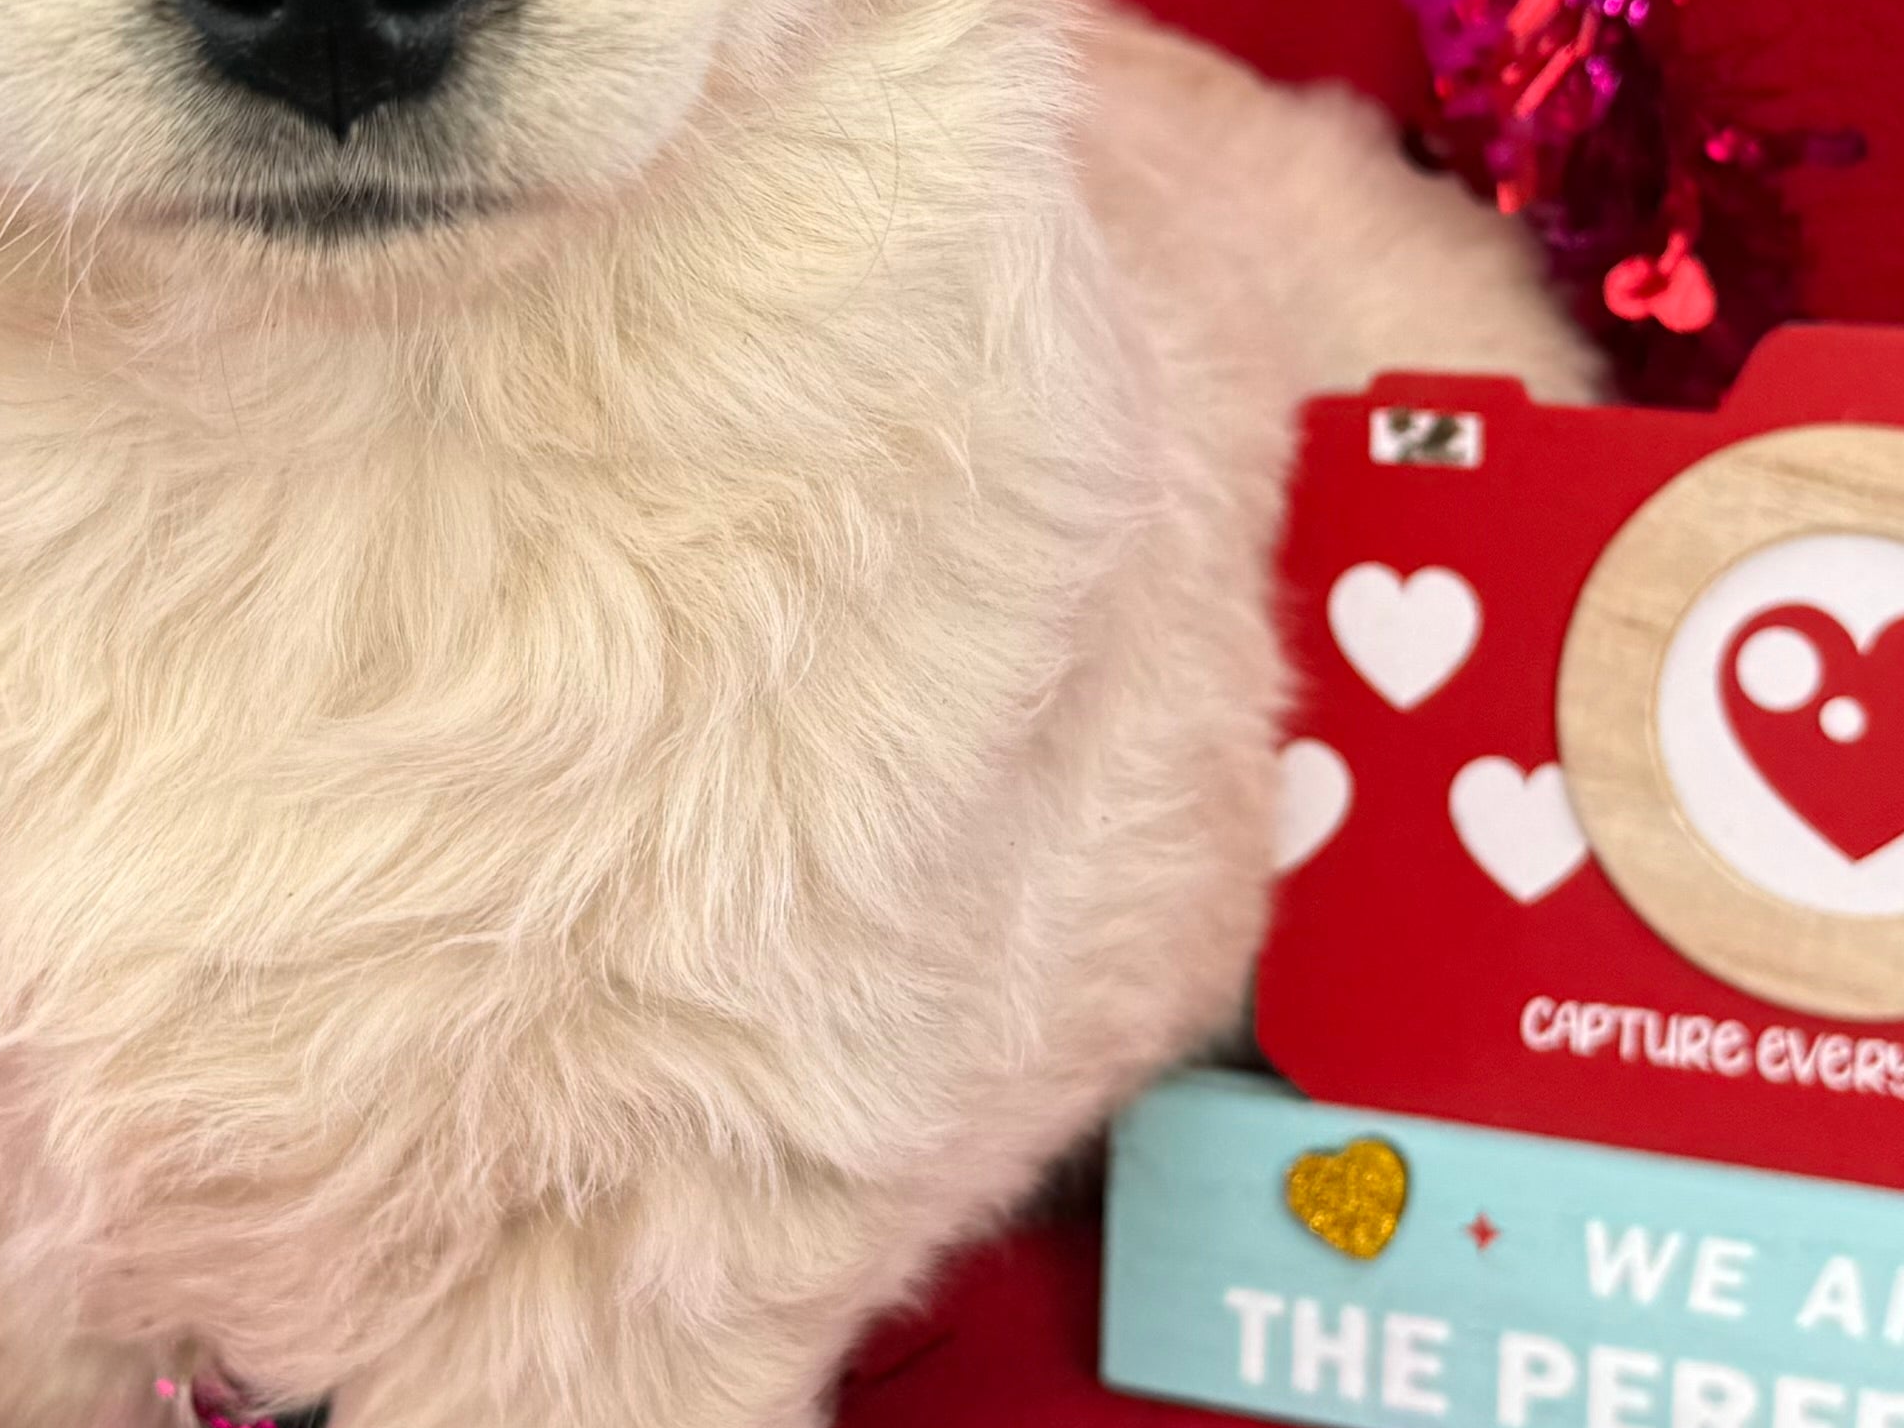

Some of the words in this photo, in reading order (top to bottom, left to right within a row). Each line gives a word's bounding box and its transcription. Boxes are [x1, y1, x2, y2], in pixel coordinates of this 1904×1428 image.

[1520, 996, 1752, 1076] CAPTURE
[1585, 1220, 1756, 1318] WE
[1223, 1288, 1450, 1417] THE
